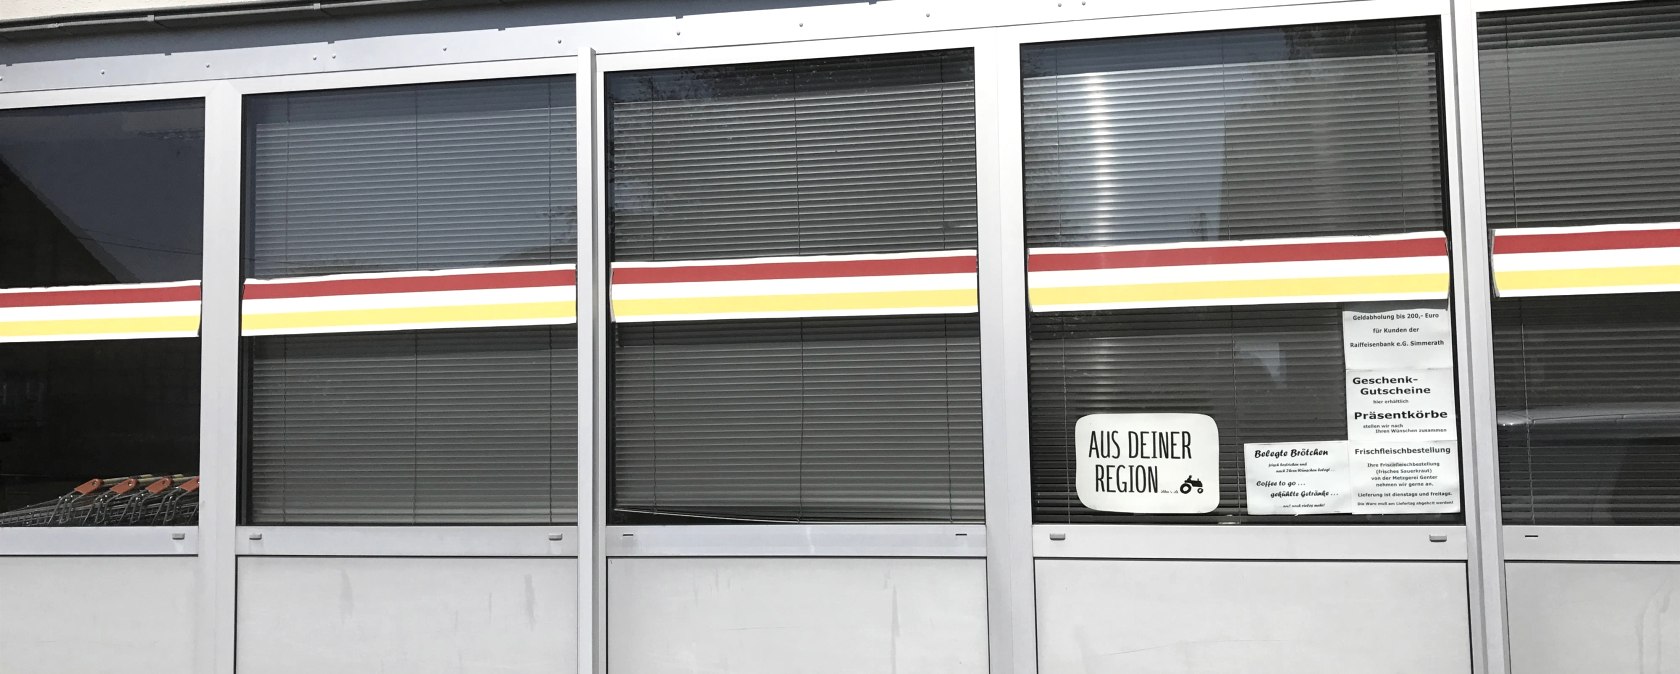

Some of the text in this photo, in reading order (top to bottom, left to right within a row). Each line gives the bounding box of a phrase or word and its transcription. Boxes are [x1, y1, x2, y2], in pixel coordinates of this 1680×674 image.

[1353, 376, 1418, 384] Geschenk-
[1360, 387, 1431, 395] Gutscheine
[1354, 410, 1448, 419] Präsentkörbe
[1089, 430, 1192, 459] AUS DEINER
[1255, 449, 1328, 459] Belegte Brötchen
[1096, 464, 1158, 493] REGION
